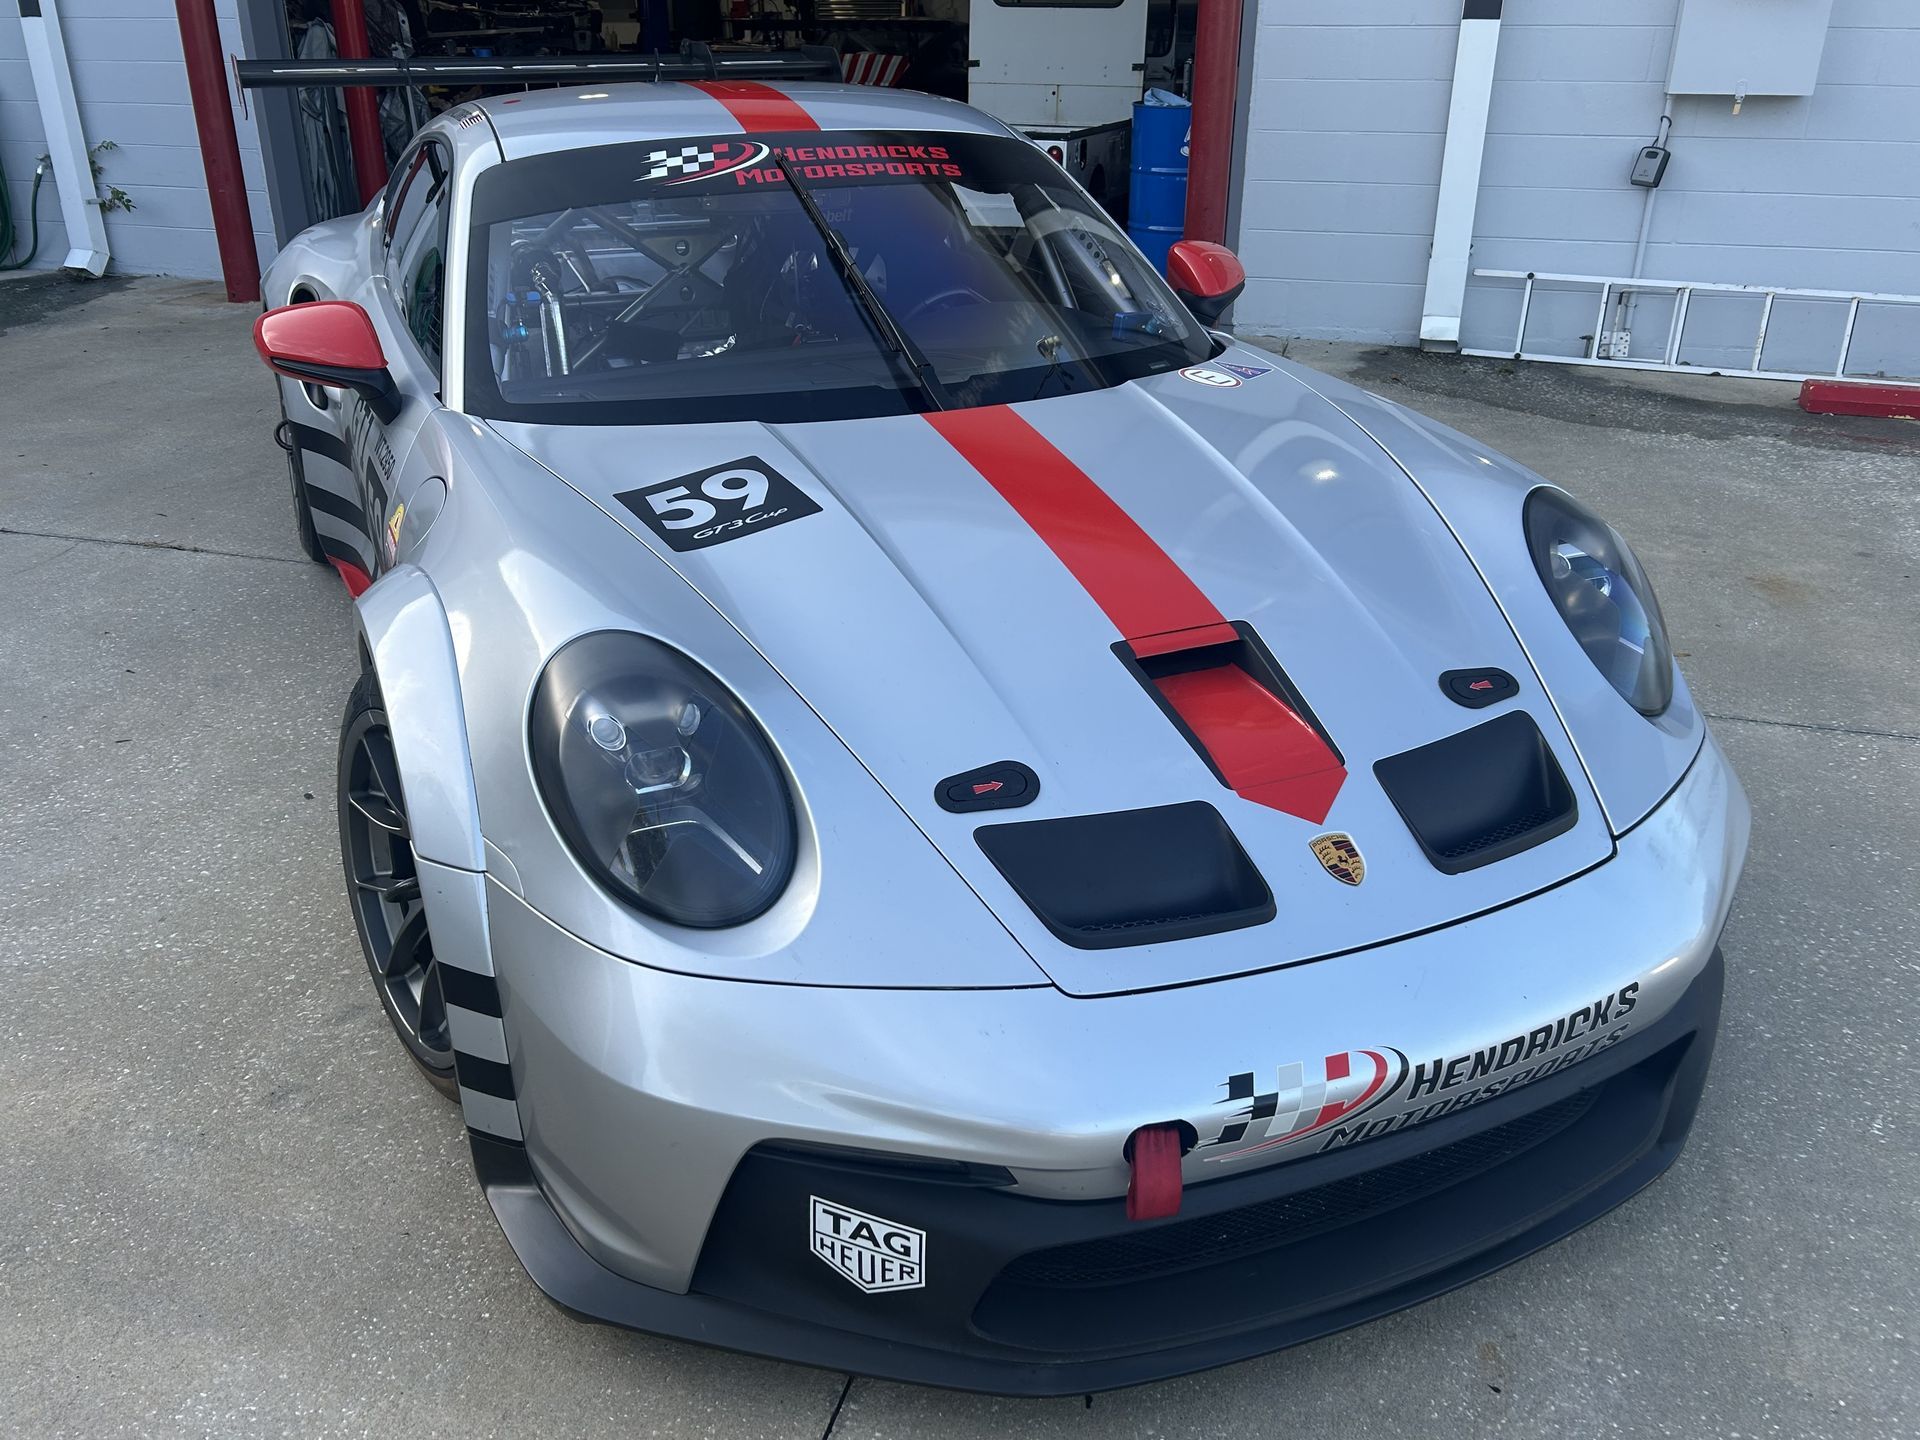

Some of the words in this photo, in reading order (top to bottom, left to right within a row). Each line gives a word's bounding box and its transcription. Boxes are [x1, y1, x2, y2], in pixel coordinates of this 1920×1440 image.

[645, 468, 770, 530] 59
[1408, 981, 1640, 1100] HENDRICKS
[1319, 1023, 1630, 1151] MOTORSPORTS
[820, 1236, 915, 1285] HEUER
[822, 1207, 911, 1258] TAG
